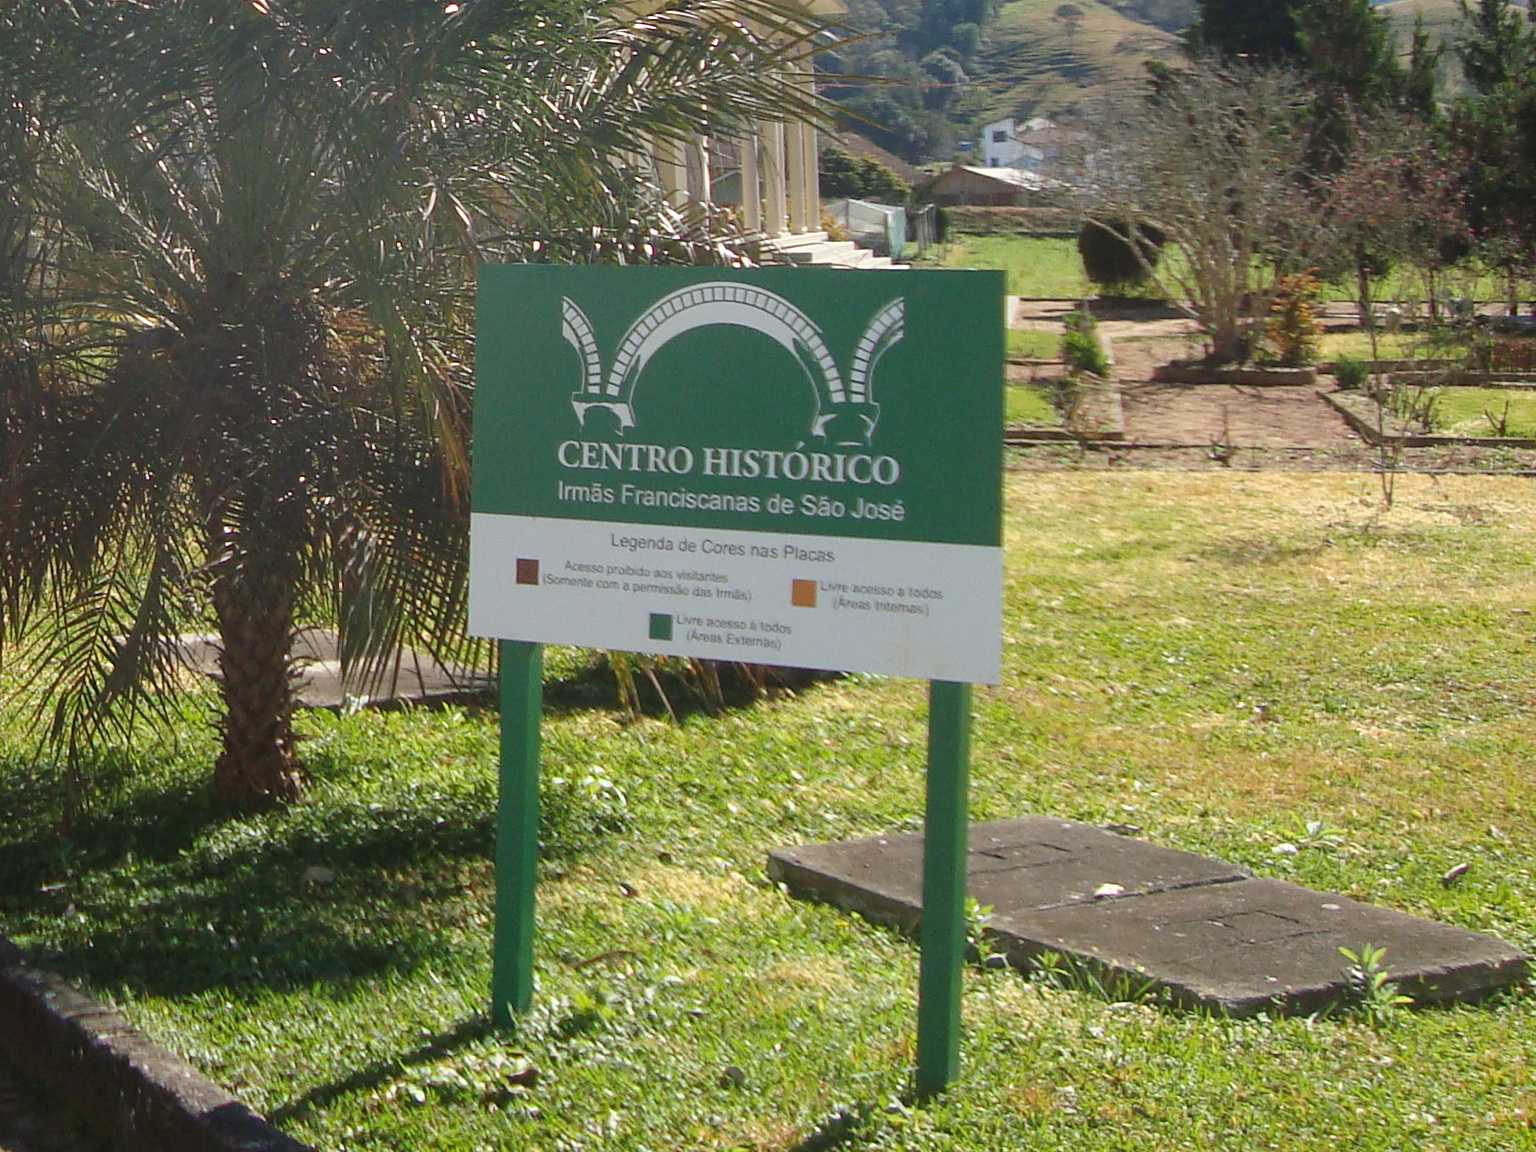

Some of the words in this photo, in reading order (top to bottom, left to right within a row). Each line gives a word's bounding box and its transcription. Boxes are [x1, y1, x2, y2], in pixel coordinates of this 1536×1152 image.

[557, 440, 694, 474] CENTRO
[702, 441, 900, 485] HISTÓRICO
[558, 480, 614, 504] Irmãs
[621, 483, 761, 513] Franciscanas
[767, 493, 795, 515] de
[800, 493, 846, 518] São
[850, 497, 906, 521] José
[610, 533, 674, 553] Legenda
[678, 538, 698, 553] de
[701, 539, 746, 556] Cores
[750, 544, 779, 559] nas
[783, 544, 836, 562] Placas
[564, 560, 604, 574] Acesso
[606, 563, 650, 577] proibido
[653, 568, 673, 579] aos
[676, 569, 729, 584] visitantes
[543, 573, 594, 588] (Somente
[595, 579, 620, 590] com
[632, 581, 690, 597] permissão
[692, 586, 713, 598] das
[820, 580, 849, 593] Livre
[676, 613, 704, 627] Livre
[759, 620, 793, 635] todos
